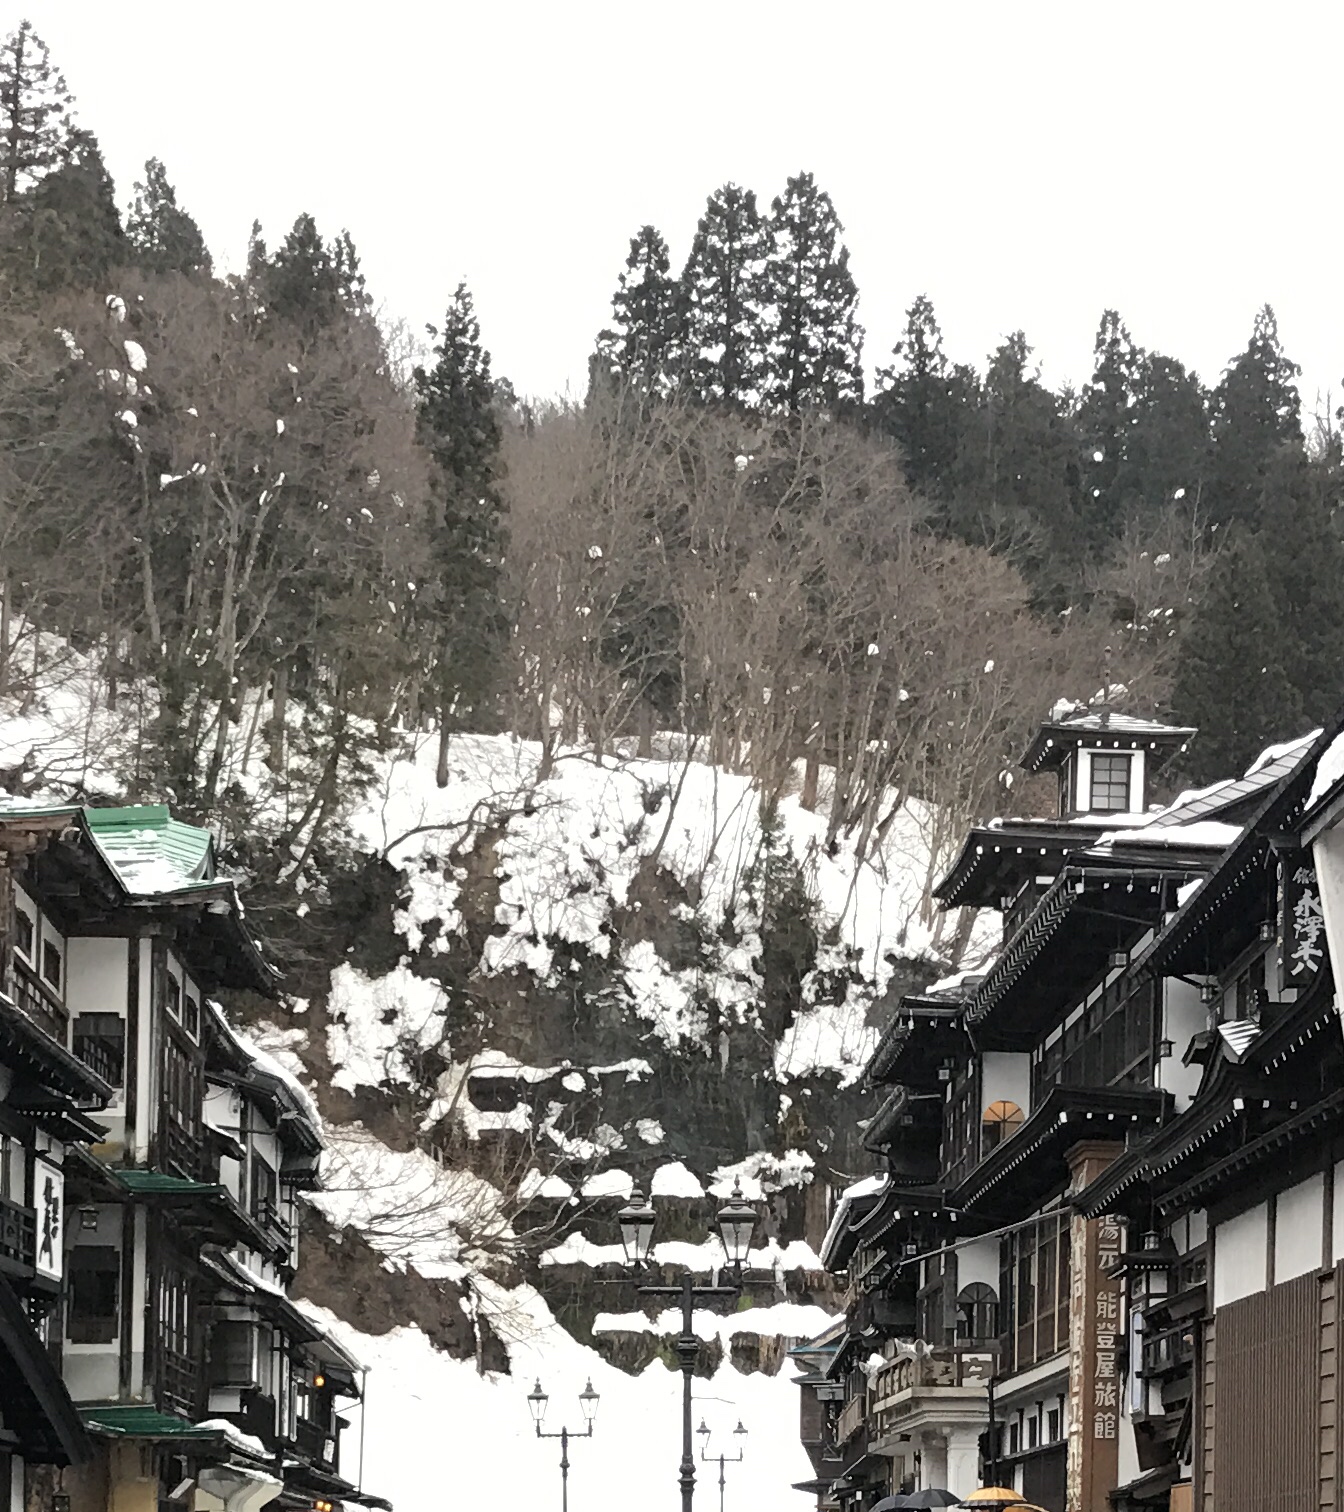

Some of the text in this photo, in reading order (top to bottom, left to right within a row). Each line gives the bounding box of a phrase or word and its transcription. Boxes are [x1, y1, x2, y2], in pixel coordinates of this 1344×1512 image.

[1291, 888, 1324, 976] 永澤平八
[1094, 1213, 1120, 1439] 湯元 能登屋旅館
